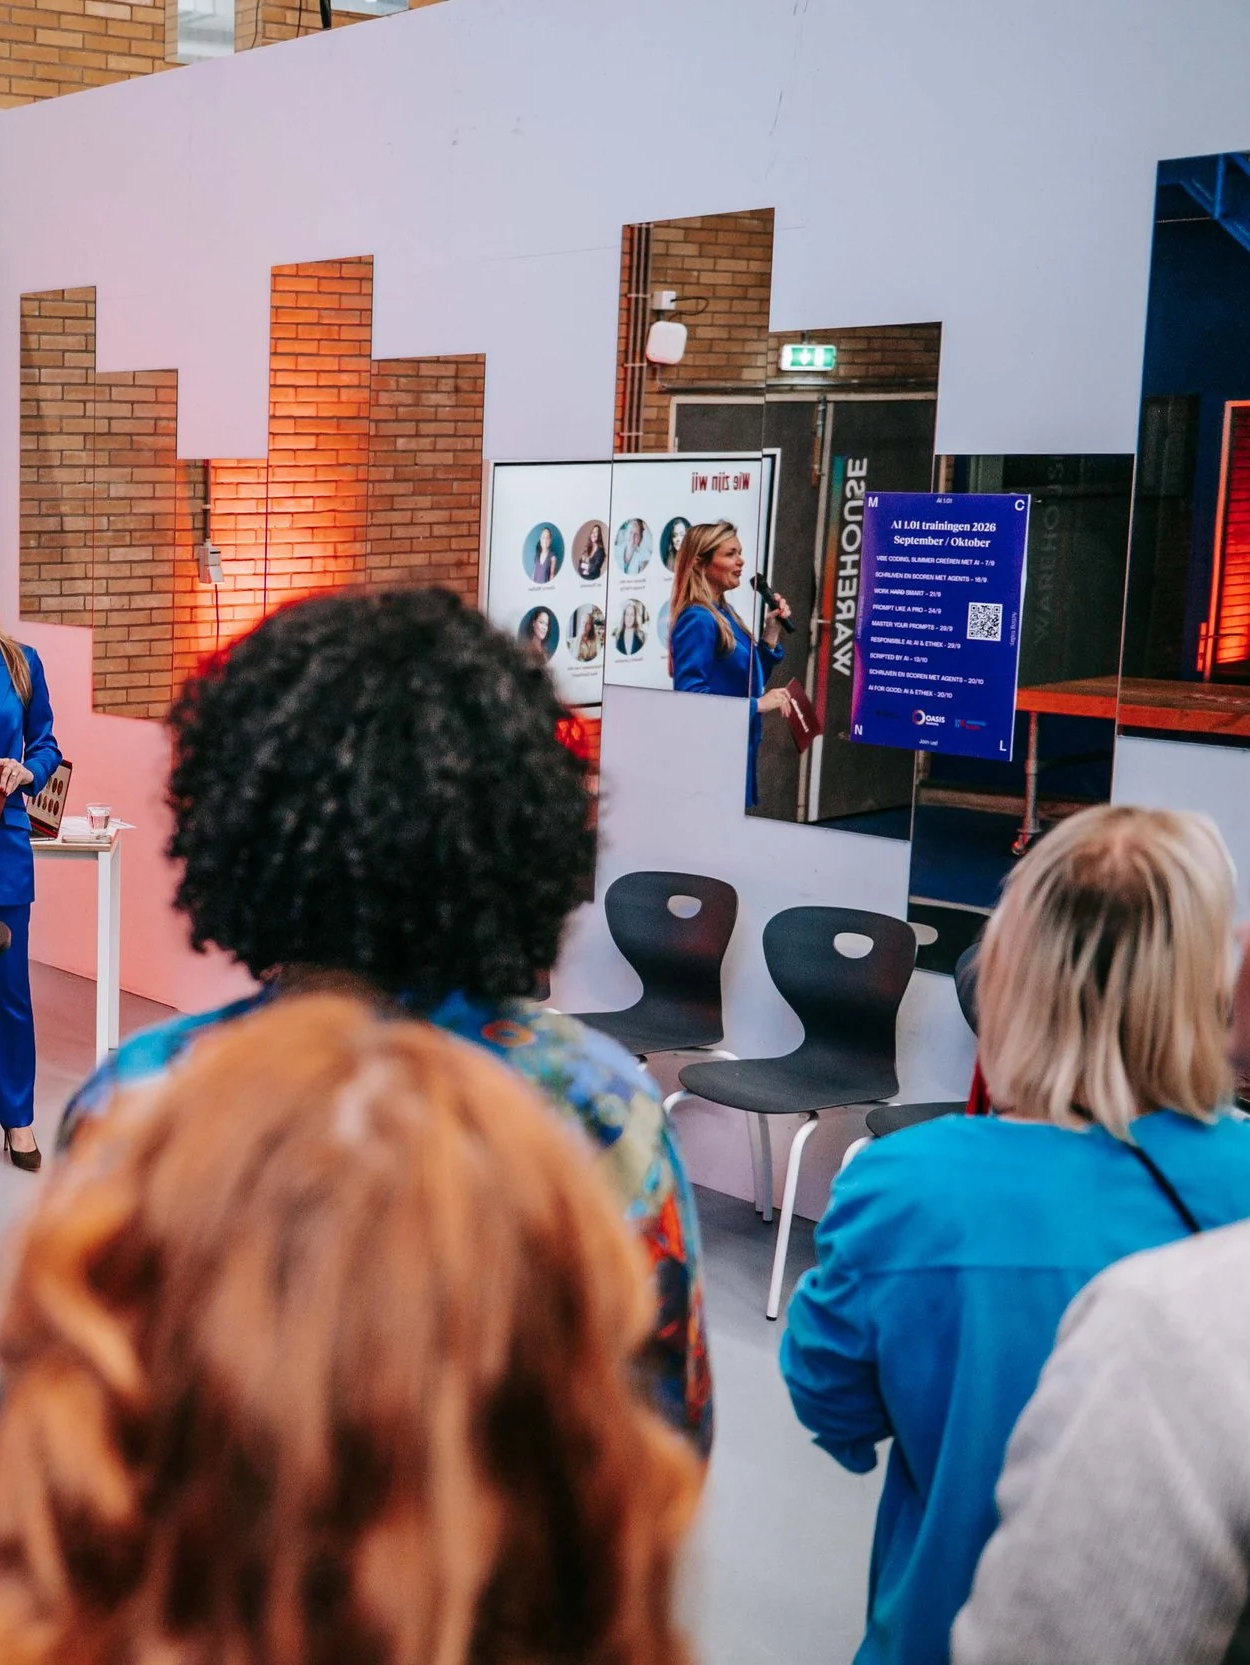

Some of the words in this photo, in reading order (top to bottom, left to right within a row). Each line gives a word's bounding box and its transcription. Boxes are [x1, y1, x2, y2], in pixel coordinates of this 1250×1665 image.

[868, 496, 879, 508] M
[1014, 499, 1025, 511] C
[891, 520, 902, 529] AI
[904, 520, 920, 530] 1.01
[922, 521, 970, 533] trainingen
[972, 522, 996, 532] 2026
[894, 535, 944, 546] September
[945, 537, 950, 546] /
[951, 537, 991, 547] Oktober
[909, 623, 934, 631] PROMPTS
[870, 652, 895, 660] SCRIPTED
[925, 715, 946, 724] OASIS
[854, 724, 863, 736] N
[999, 740, 1007, 751] L
